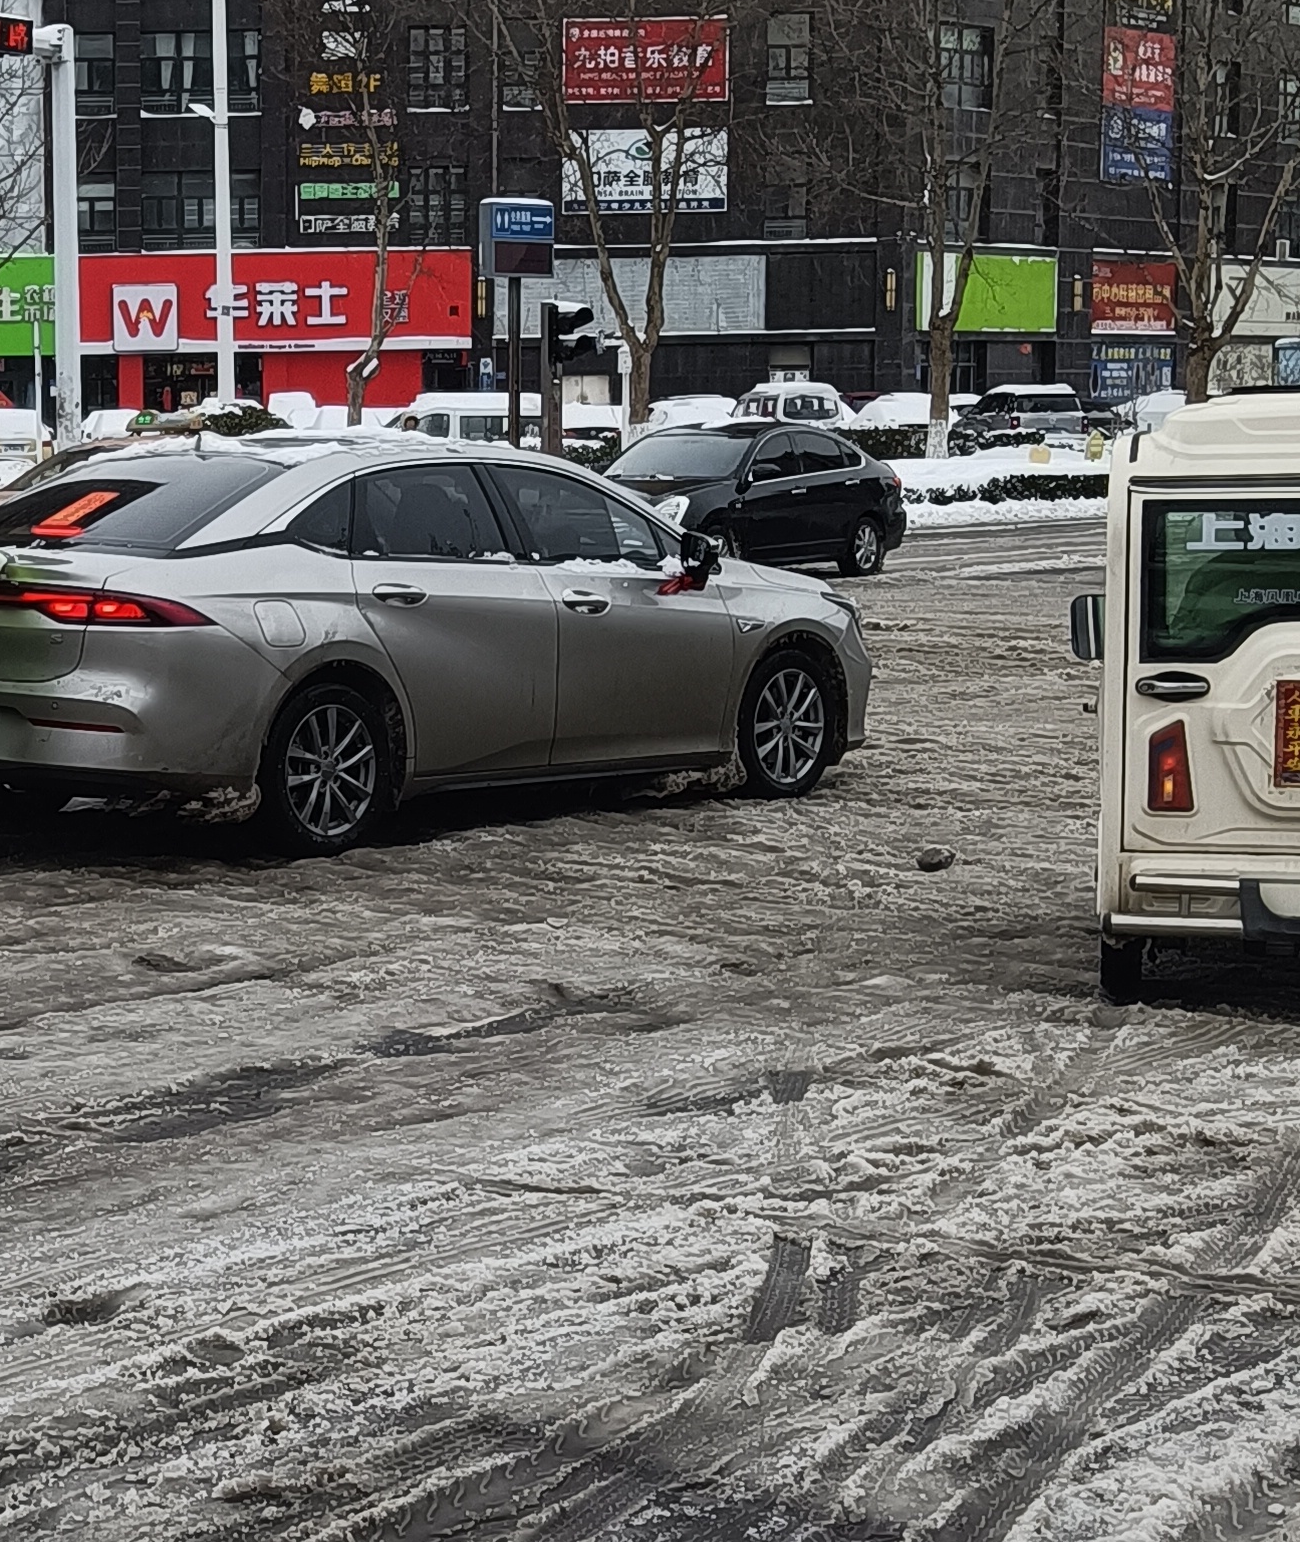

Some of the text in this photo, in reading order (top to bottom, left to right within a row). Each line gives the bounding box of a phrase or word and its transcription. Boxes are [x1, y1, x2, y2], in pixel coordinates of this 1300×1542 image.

[618, 188, 644, 197] BRAIN
[205, 280, 348, 327] 华莱士
